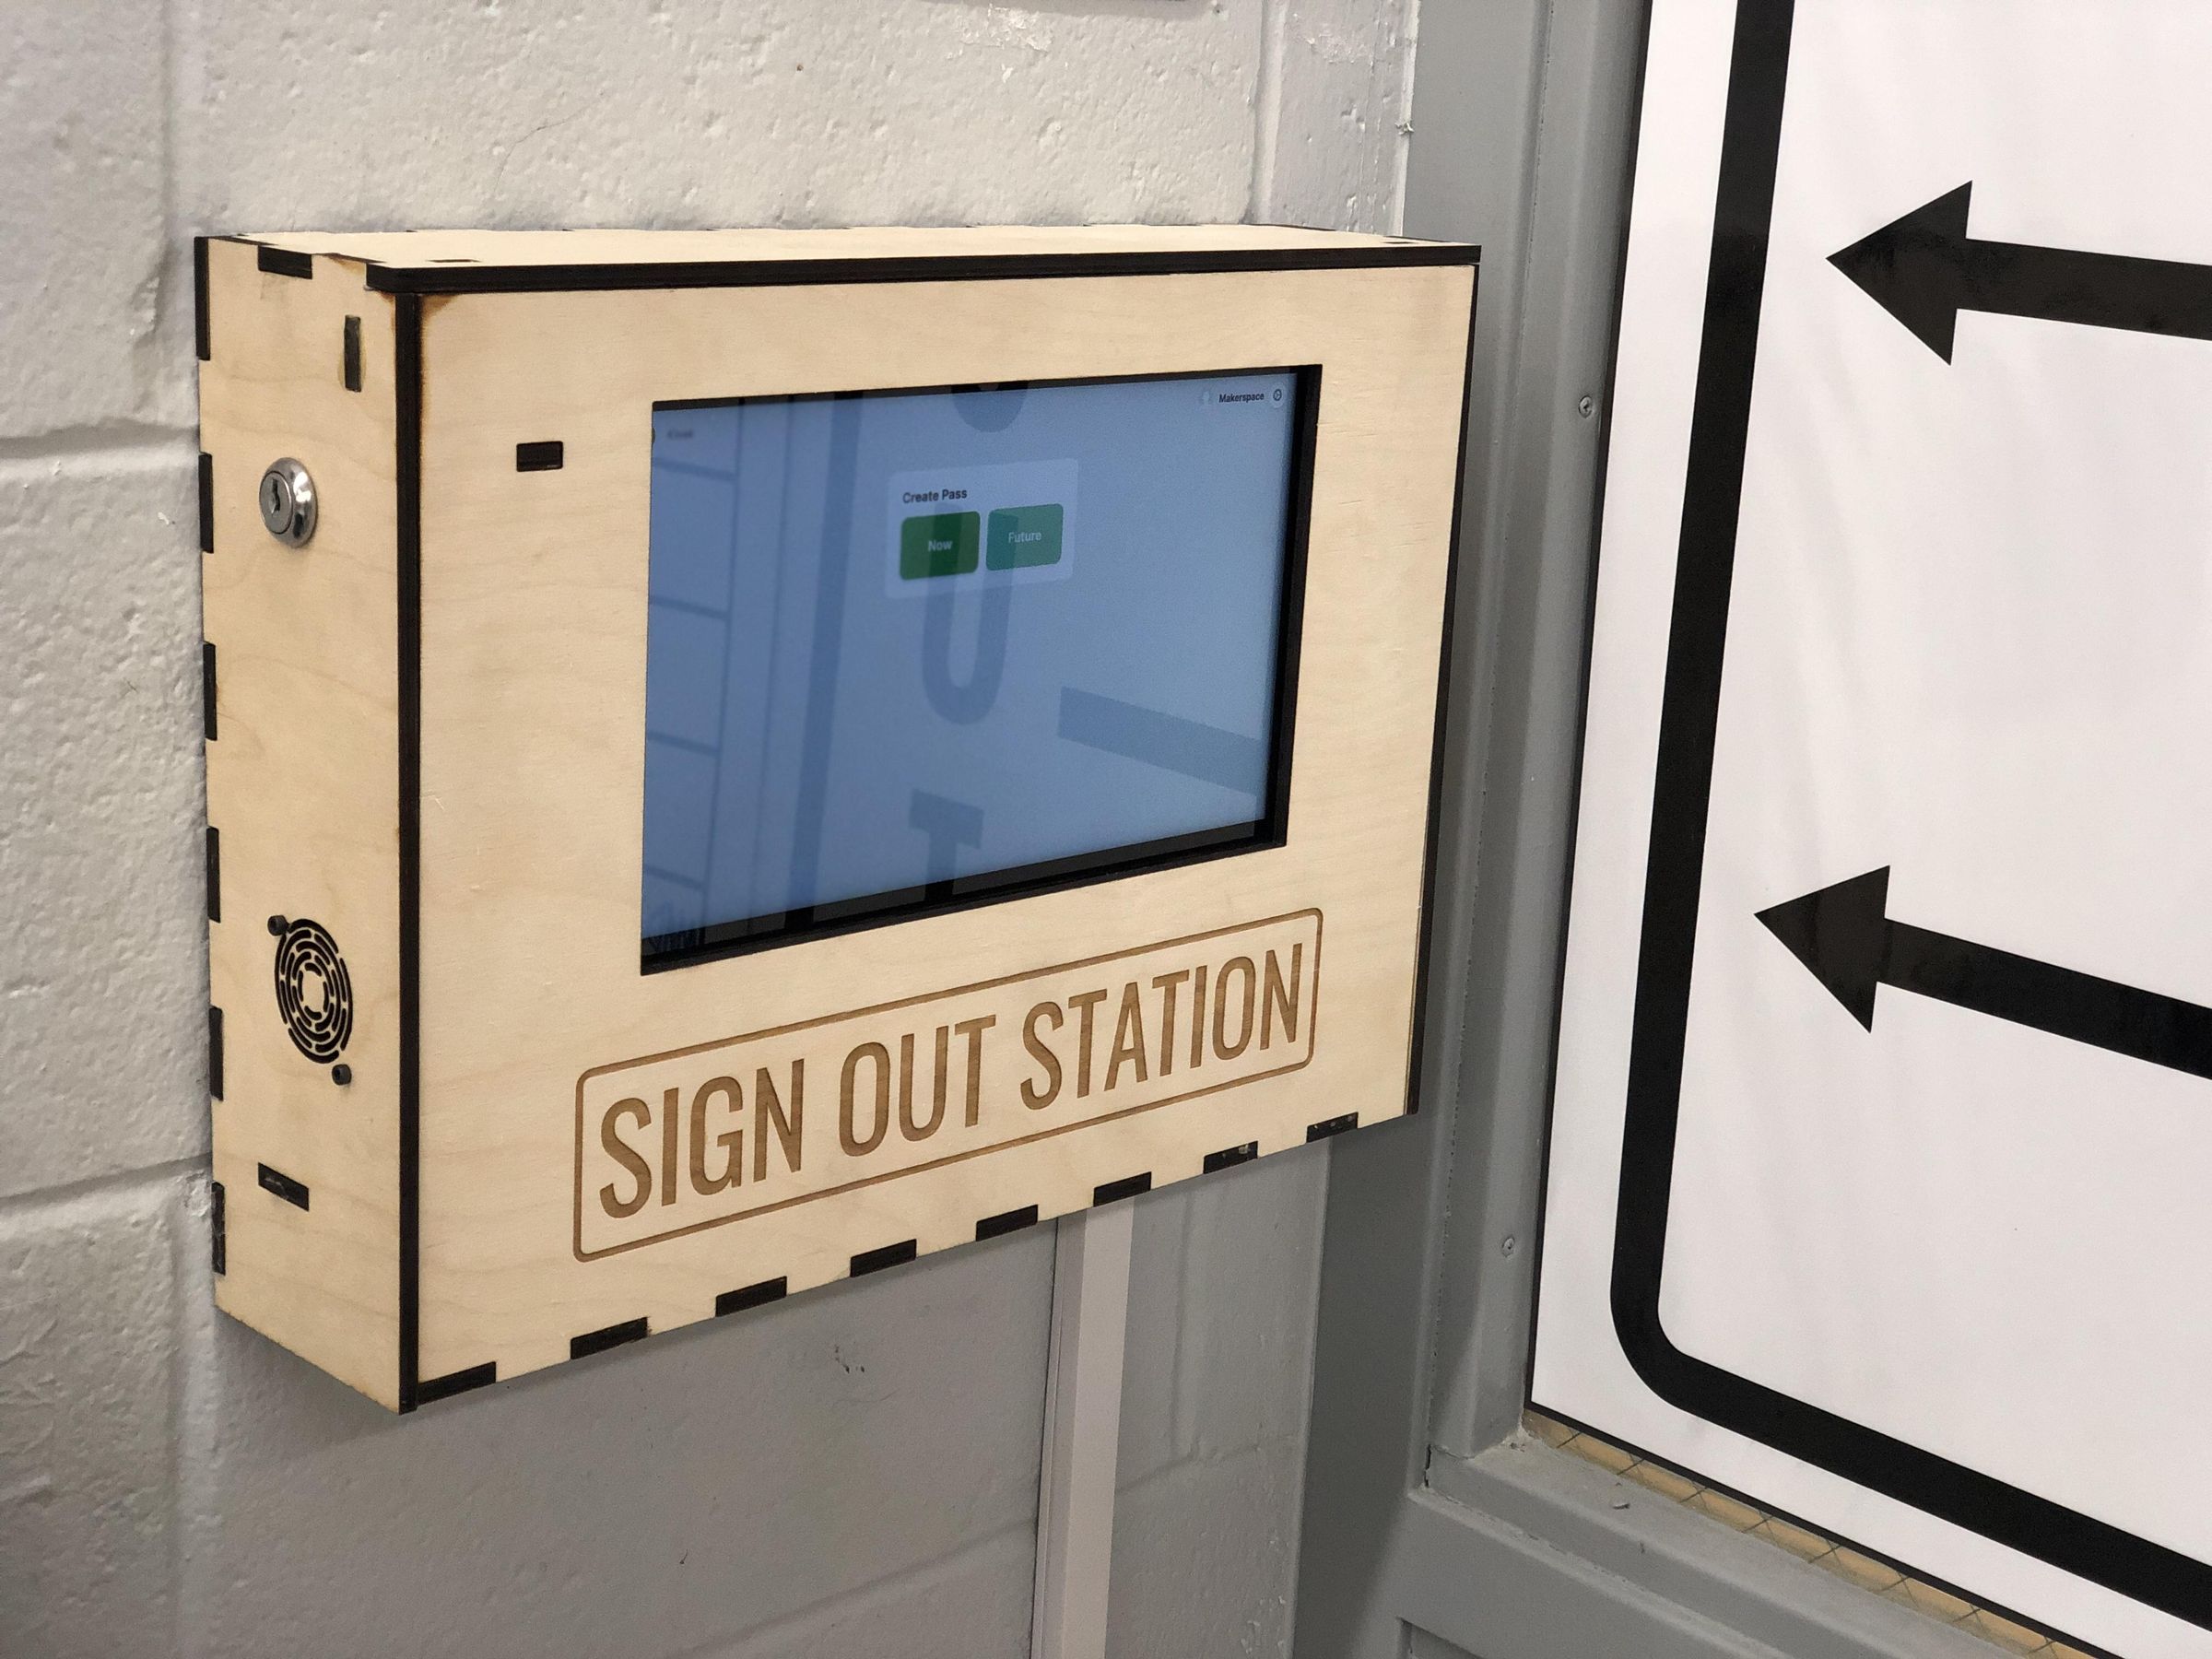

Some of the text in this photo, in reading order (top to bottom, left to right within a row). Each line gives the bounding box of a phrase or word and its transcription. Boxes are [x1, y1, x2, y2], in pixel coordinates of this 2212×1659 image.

[1218, 393, 1265, 404] Makerspace
[902, 488, 968, 504] Create Pass
[1007, 531, 1042, 544] Future
[927, 539, 952, 552] Now
[599, 943, 1304, 1218] SIGN OUT STATION
